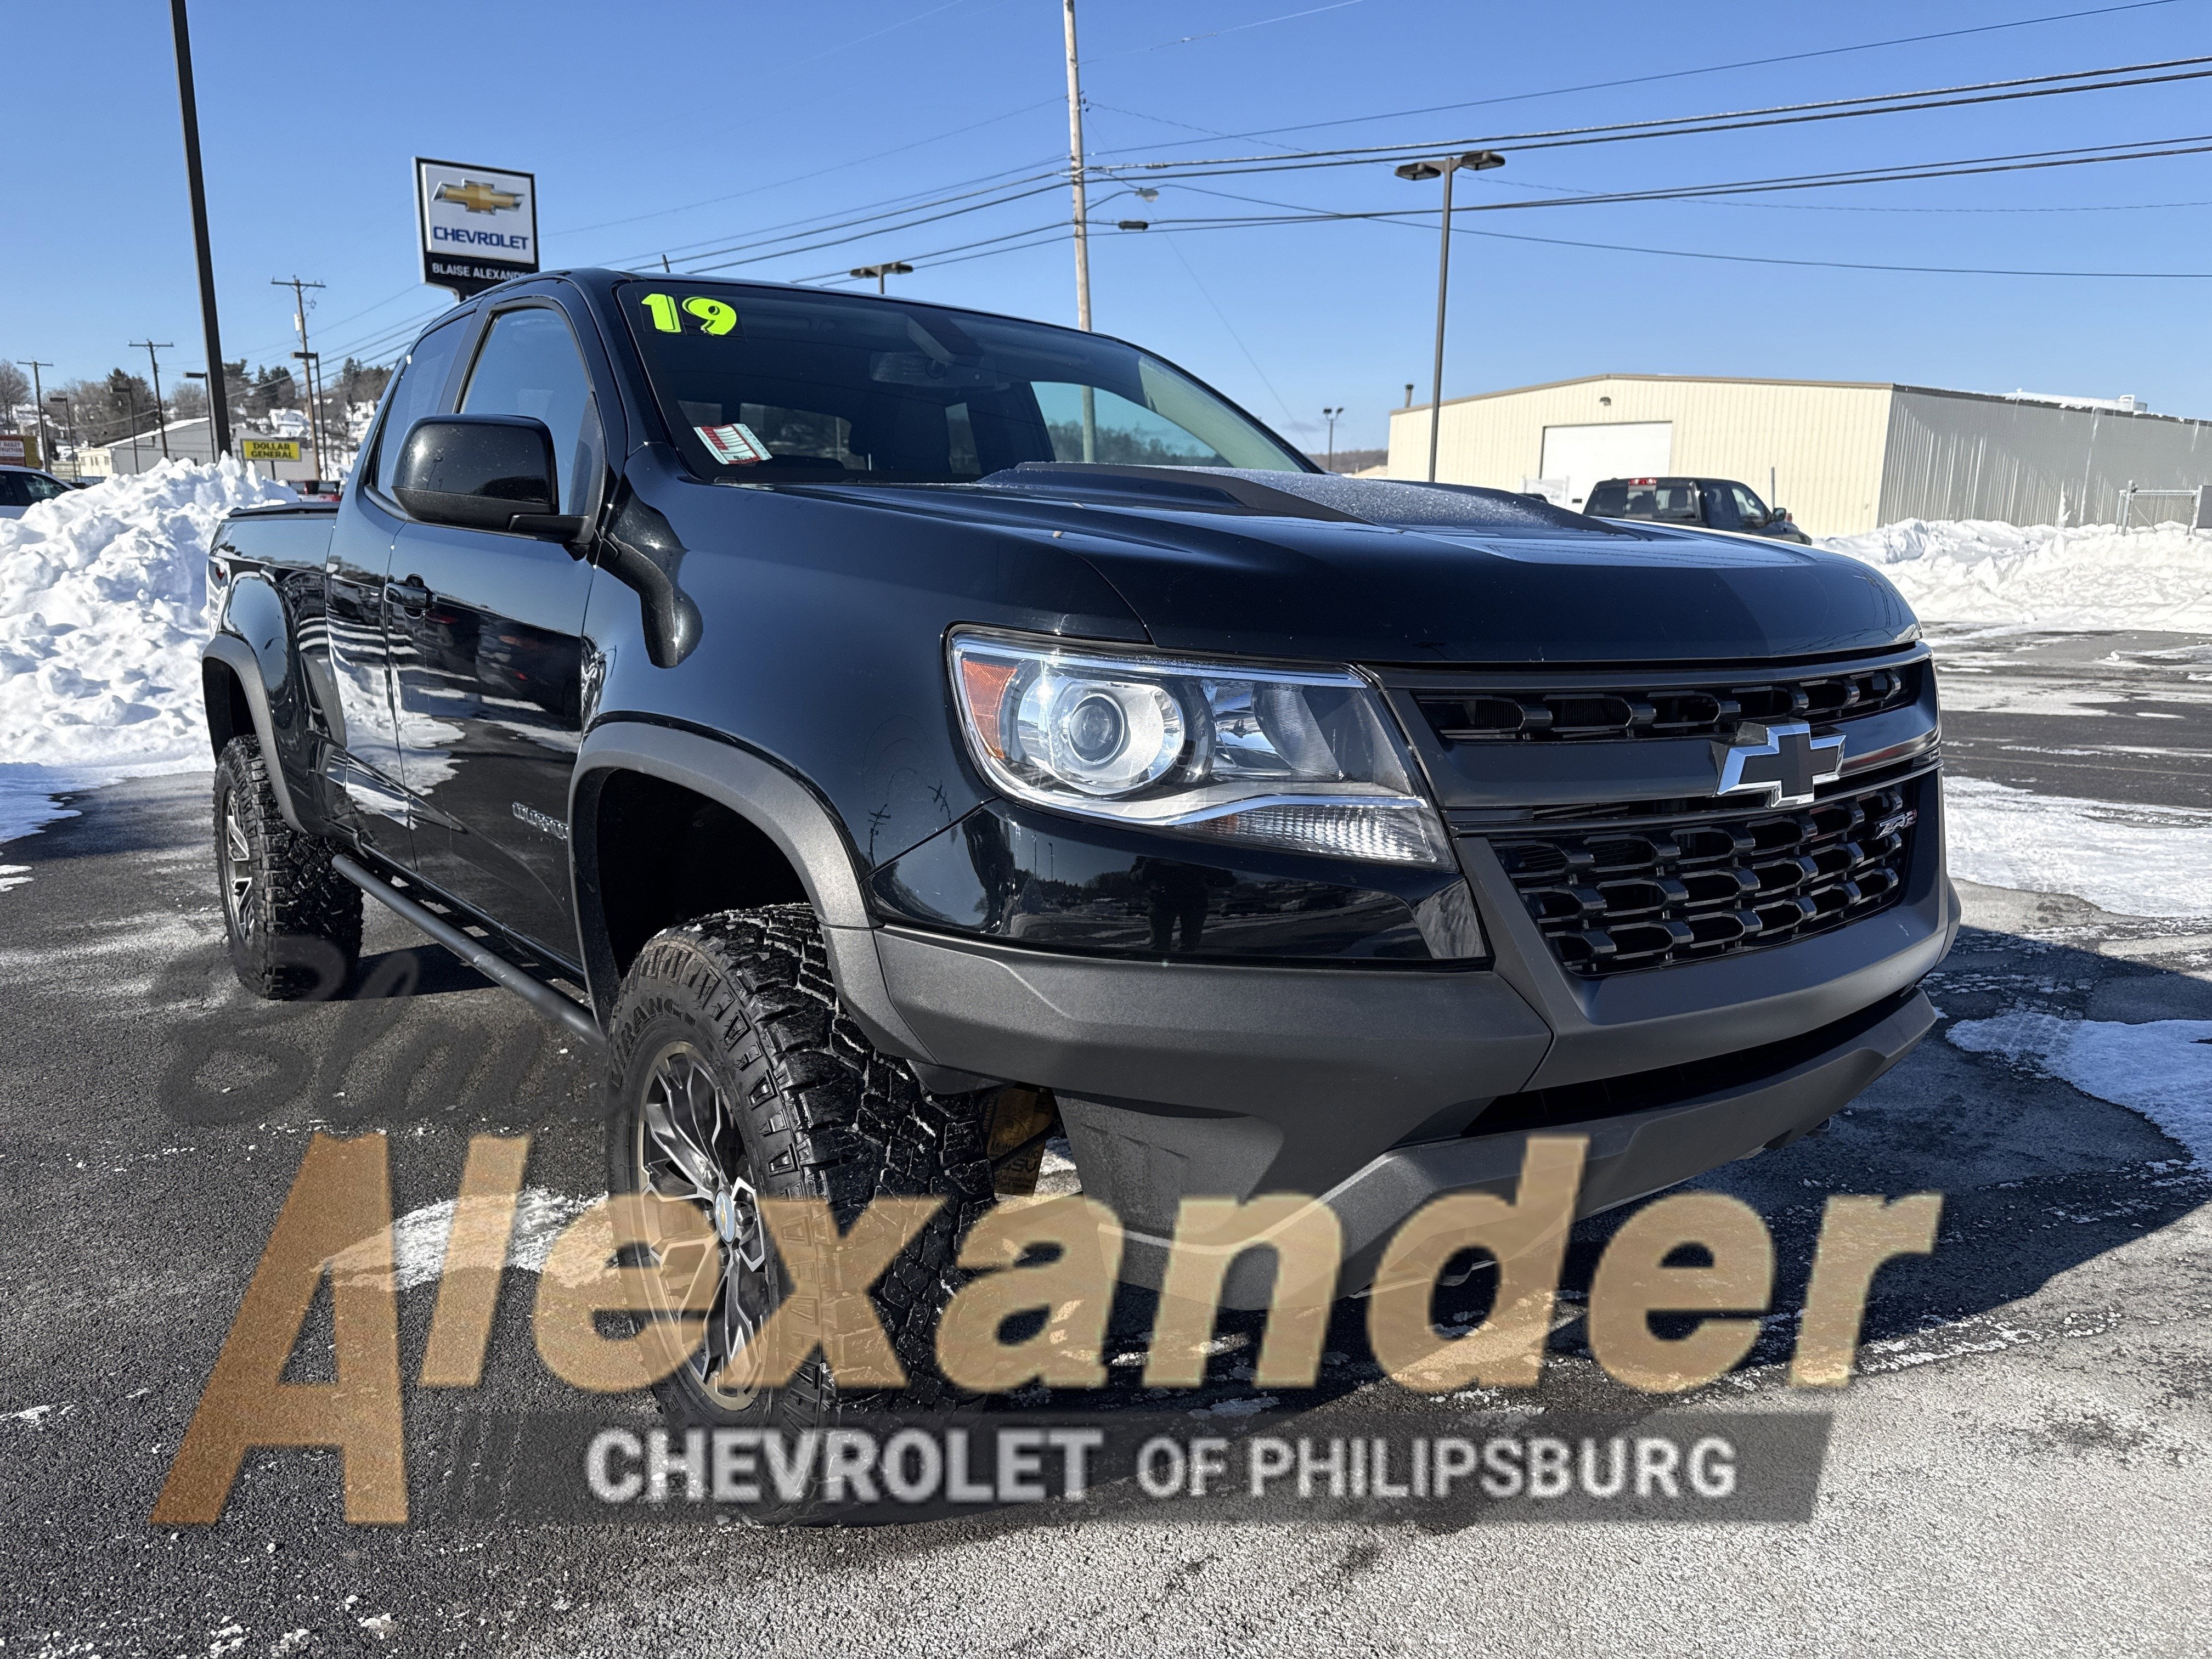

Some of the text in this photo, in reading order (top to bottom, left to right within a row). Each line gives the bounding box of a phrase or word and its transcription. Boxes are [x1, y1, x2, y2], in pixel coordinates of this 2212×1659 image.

[433, 227, 529, 250] CHEVROLET
[432, 262, 532, 281] BLAISE ALEXAND
[641, 294, 737, 337] 19
[251, 450, 294, 459] GENERAL
[252, 442, 291, 450] DOLLAR
[1875, 809, 1917, 840] ZR2
